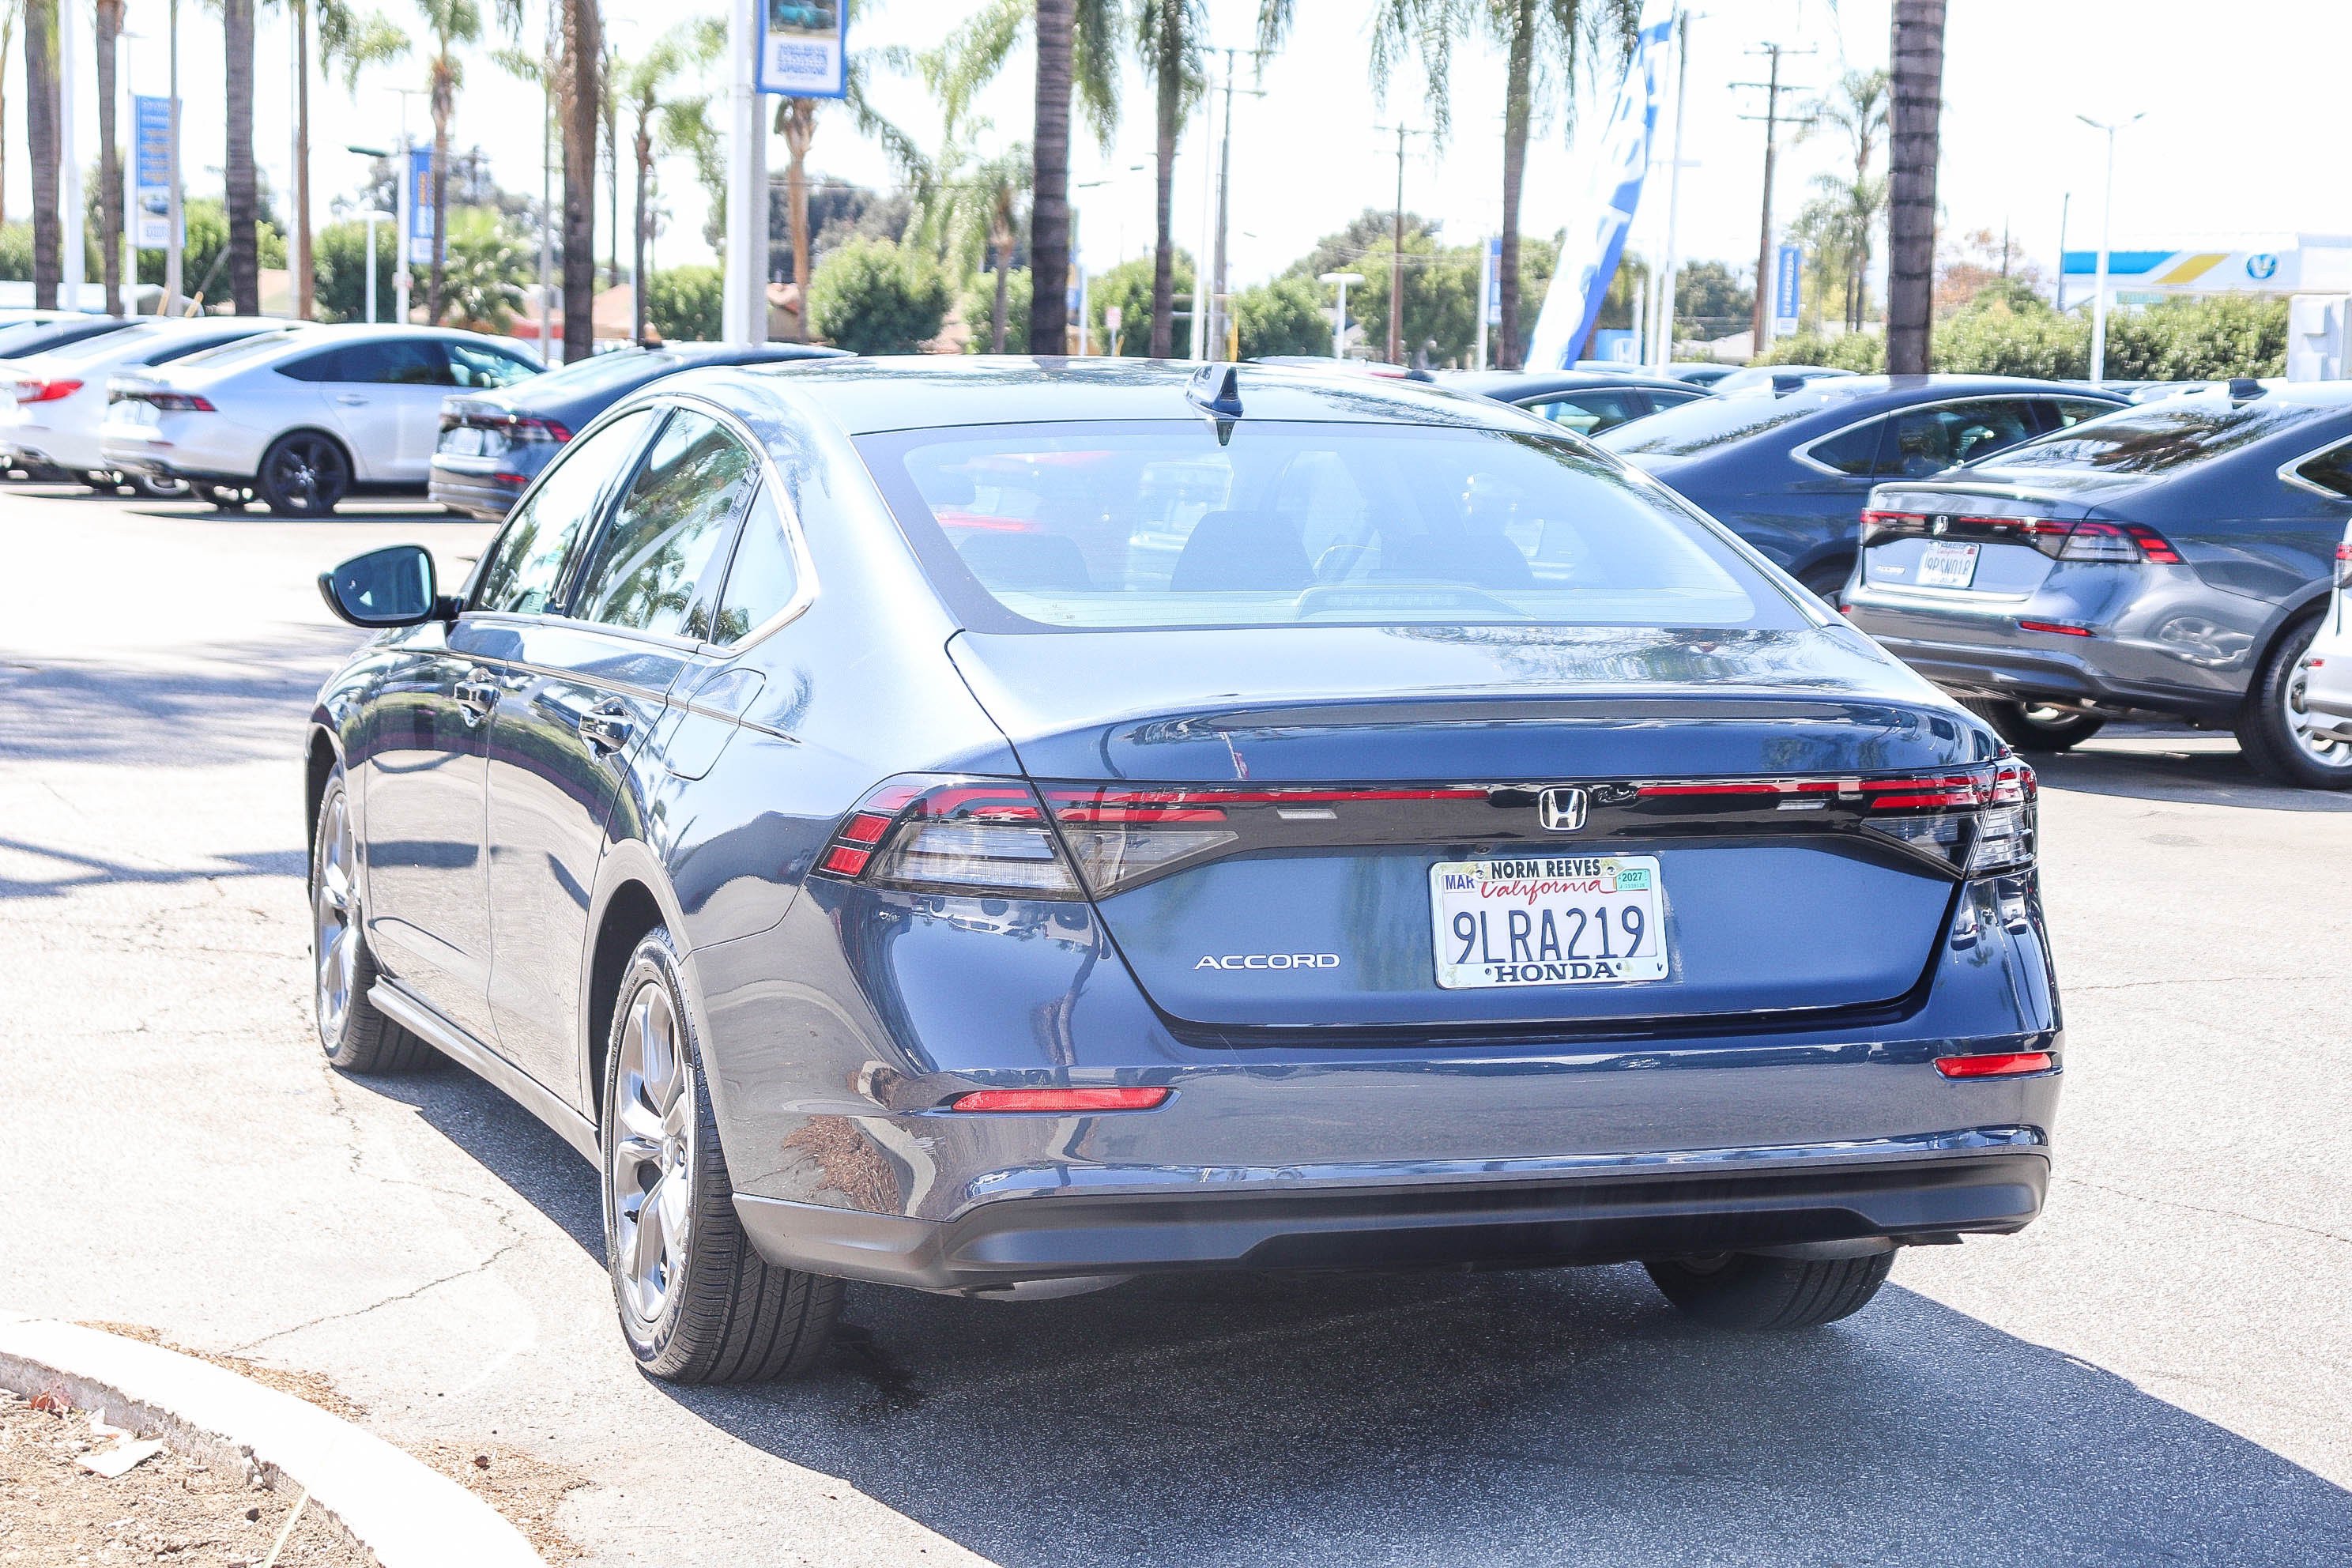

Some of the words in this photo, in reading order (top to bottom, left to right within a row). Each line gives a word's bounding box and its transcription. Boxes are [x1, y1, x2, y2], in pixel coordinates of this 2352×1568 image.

[1491, 861, 1540, 880] NORM
[1546, 858, 1601, 877] REEVES
[1622, 872, 1643, 882] 2027
[1446, 874, 1475, 890] MAR
[1481, 879, 1617, 906] California
[1453, 905, 1645, 964] 9LRA219
[1193, 952, 1341, 971] ACCORD
[1494, 961, 1619, 982] HONDA
